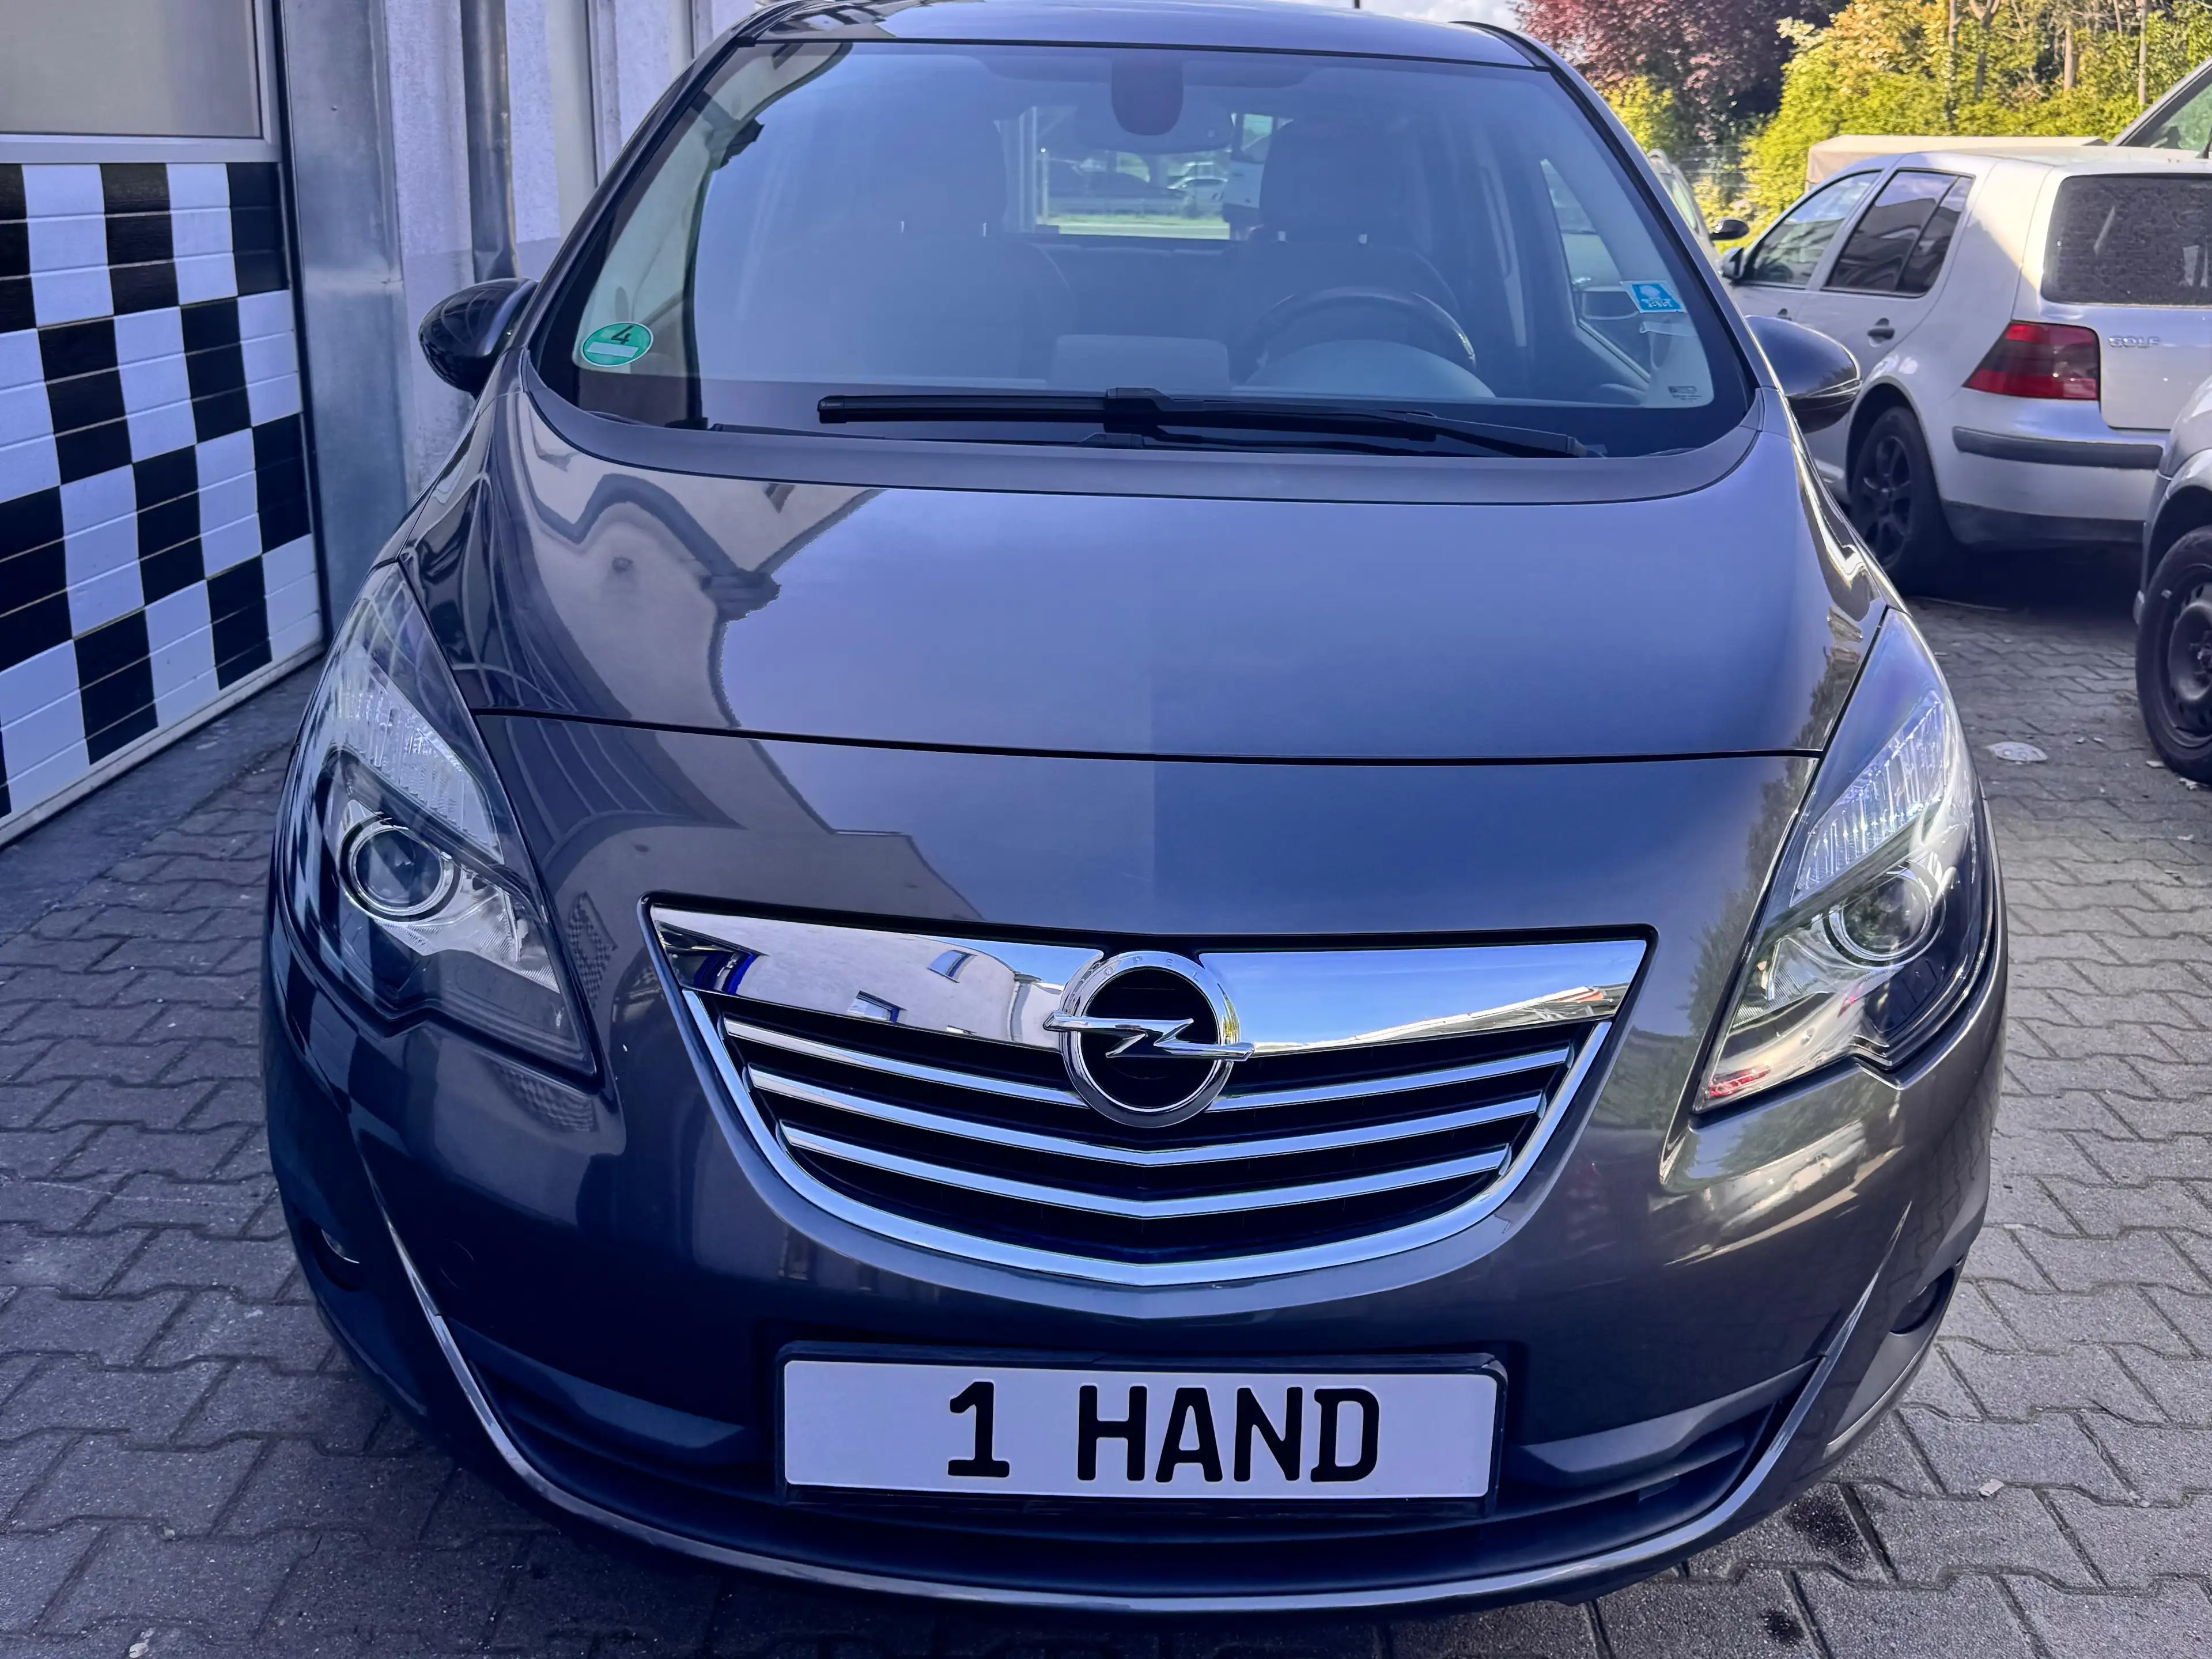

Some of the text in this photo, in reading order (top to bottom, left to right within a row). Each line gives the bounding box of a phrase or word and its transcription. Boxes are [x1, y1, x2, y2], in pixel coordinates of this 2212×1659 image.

[611, 325, 634, 344] 4
[2109, 336, 2161, 349] GOLF
[1104, 956, 1199, 983] OPEL
[947, 1381, 1380, 1483] 1 HAND
